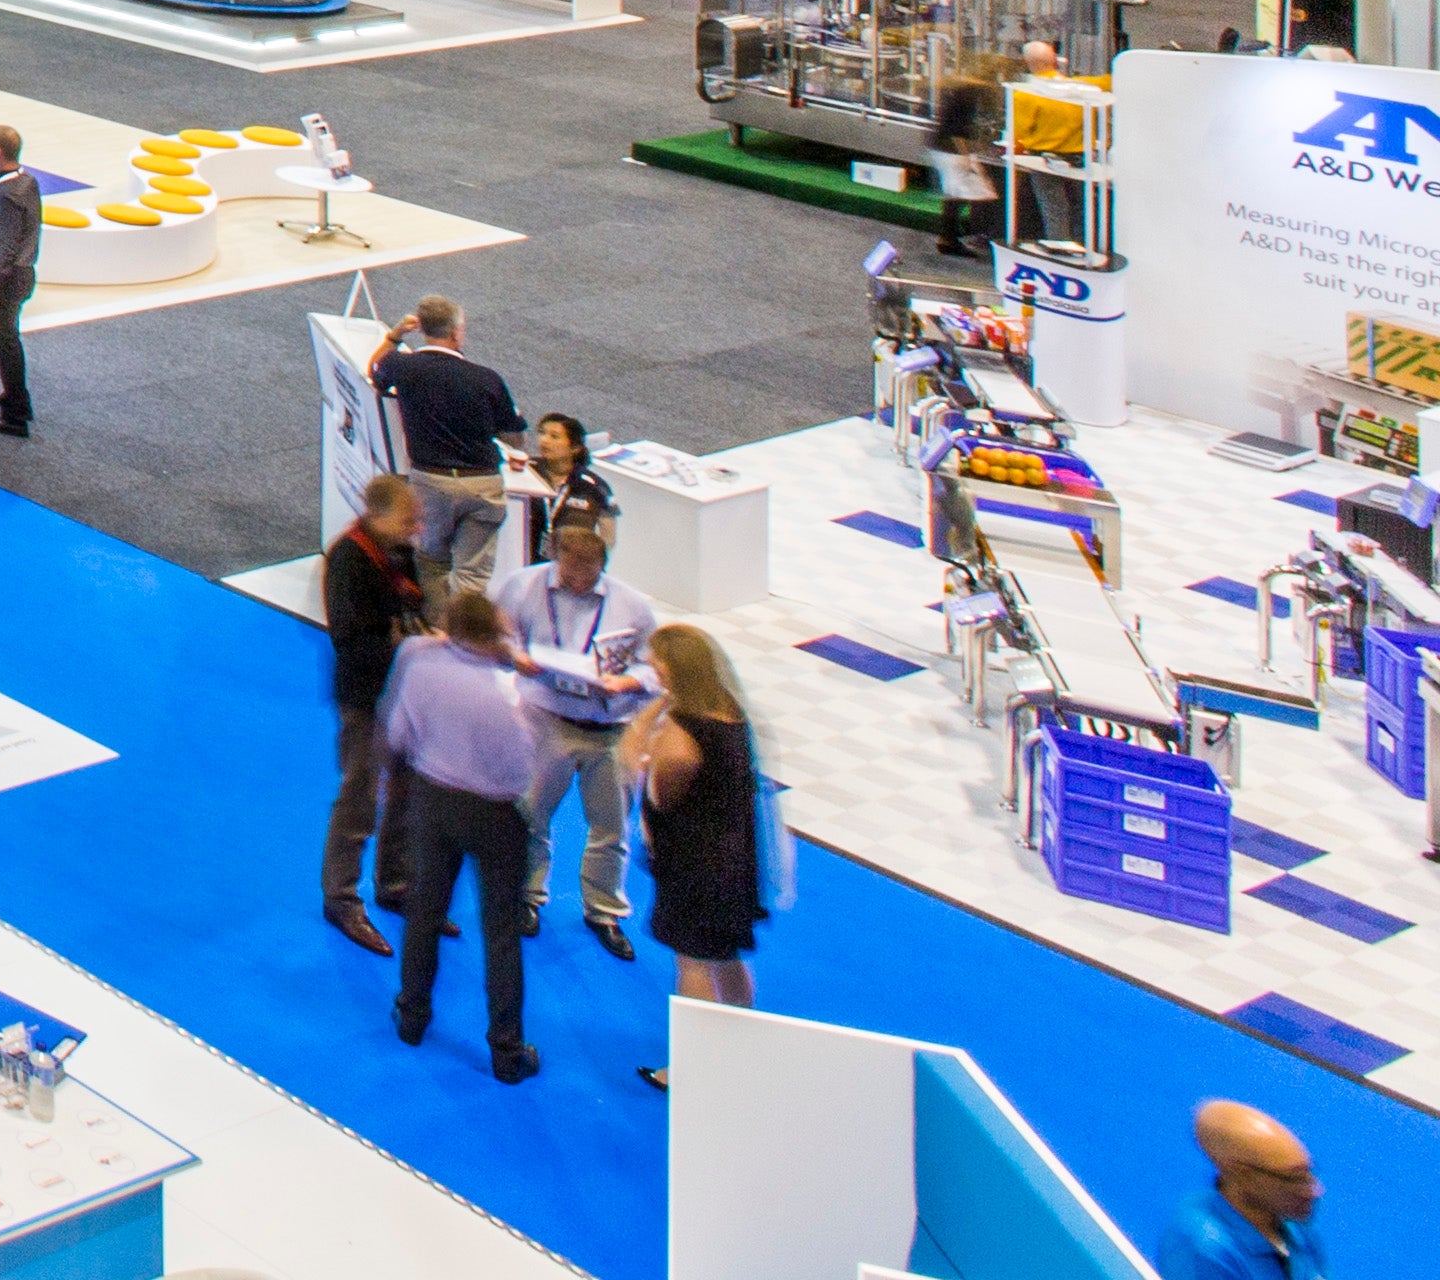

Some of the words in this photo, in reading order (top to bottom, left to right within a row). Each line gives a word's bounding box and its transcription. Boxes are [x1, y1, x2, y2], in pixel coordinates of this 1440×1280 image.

[1293, 152, 1374, 182] A&D
[1226, 202, 1350, 245] Measuring
[1239, 230, 1292, 253] A&D
[1299, 241, 1339, 265] has
[1347, 255, 1387, 276] the
[1006, 262, 1090, 303] AND
[1303, 271, 1345, 292] suit
[1354, 282, 1410, 306] your
